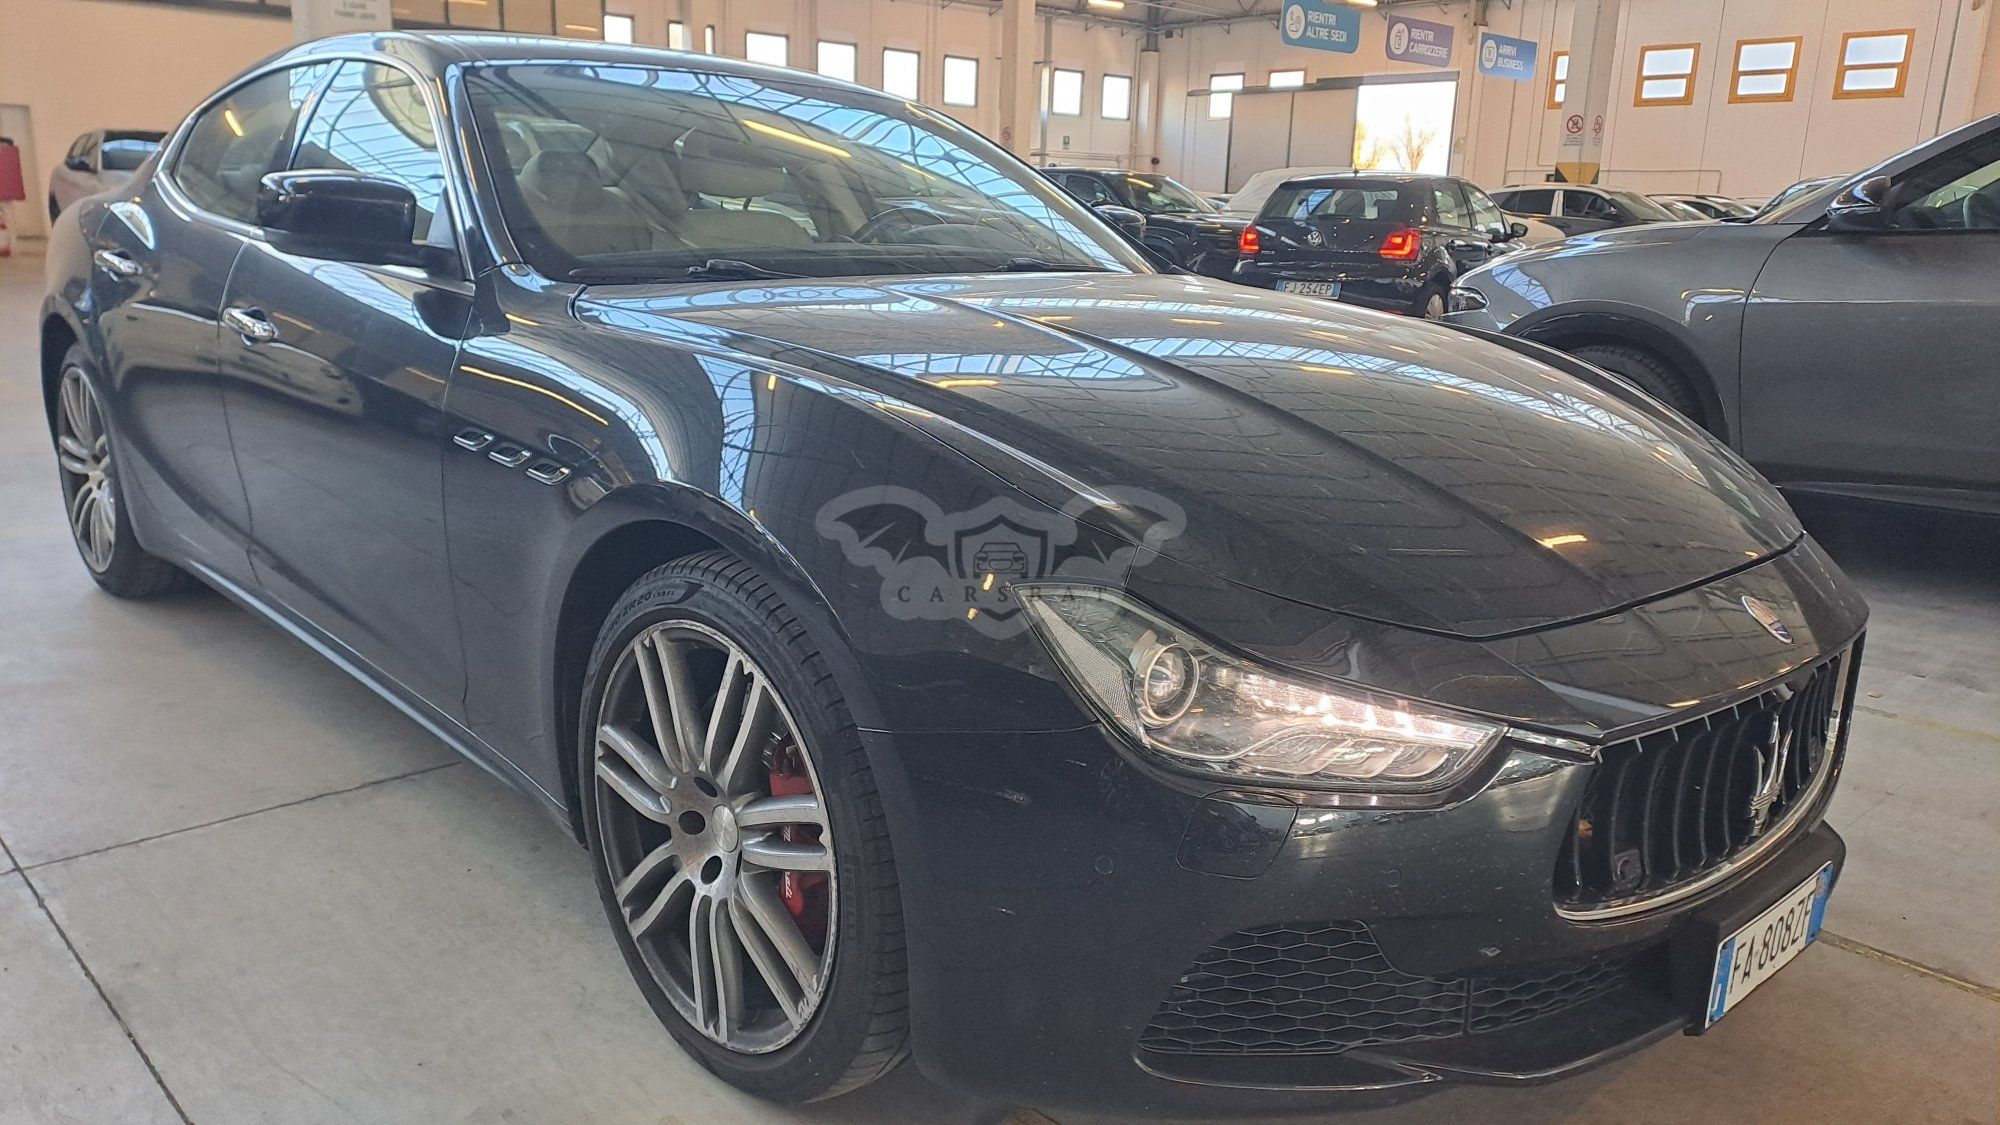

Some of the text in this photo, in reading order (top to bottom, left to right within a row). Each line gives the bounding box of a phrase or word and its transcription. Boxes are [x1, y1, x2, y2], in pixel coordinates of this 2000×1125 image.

[1308, 10, 1337, 26] RIENTRI
[1306, 26, 1348, 42] ALTRE SEDI
[1410, 28, 1435, 42] RIENTRI
[1408, 42, 1449, 59] CARROZZERIE
[1498, 45, 1517, 57] ARRIVI
[1497, 57, 1524, 71] BUSINESS
[1284, 282, 1332, 295] FJ 254EP
